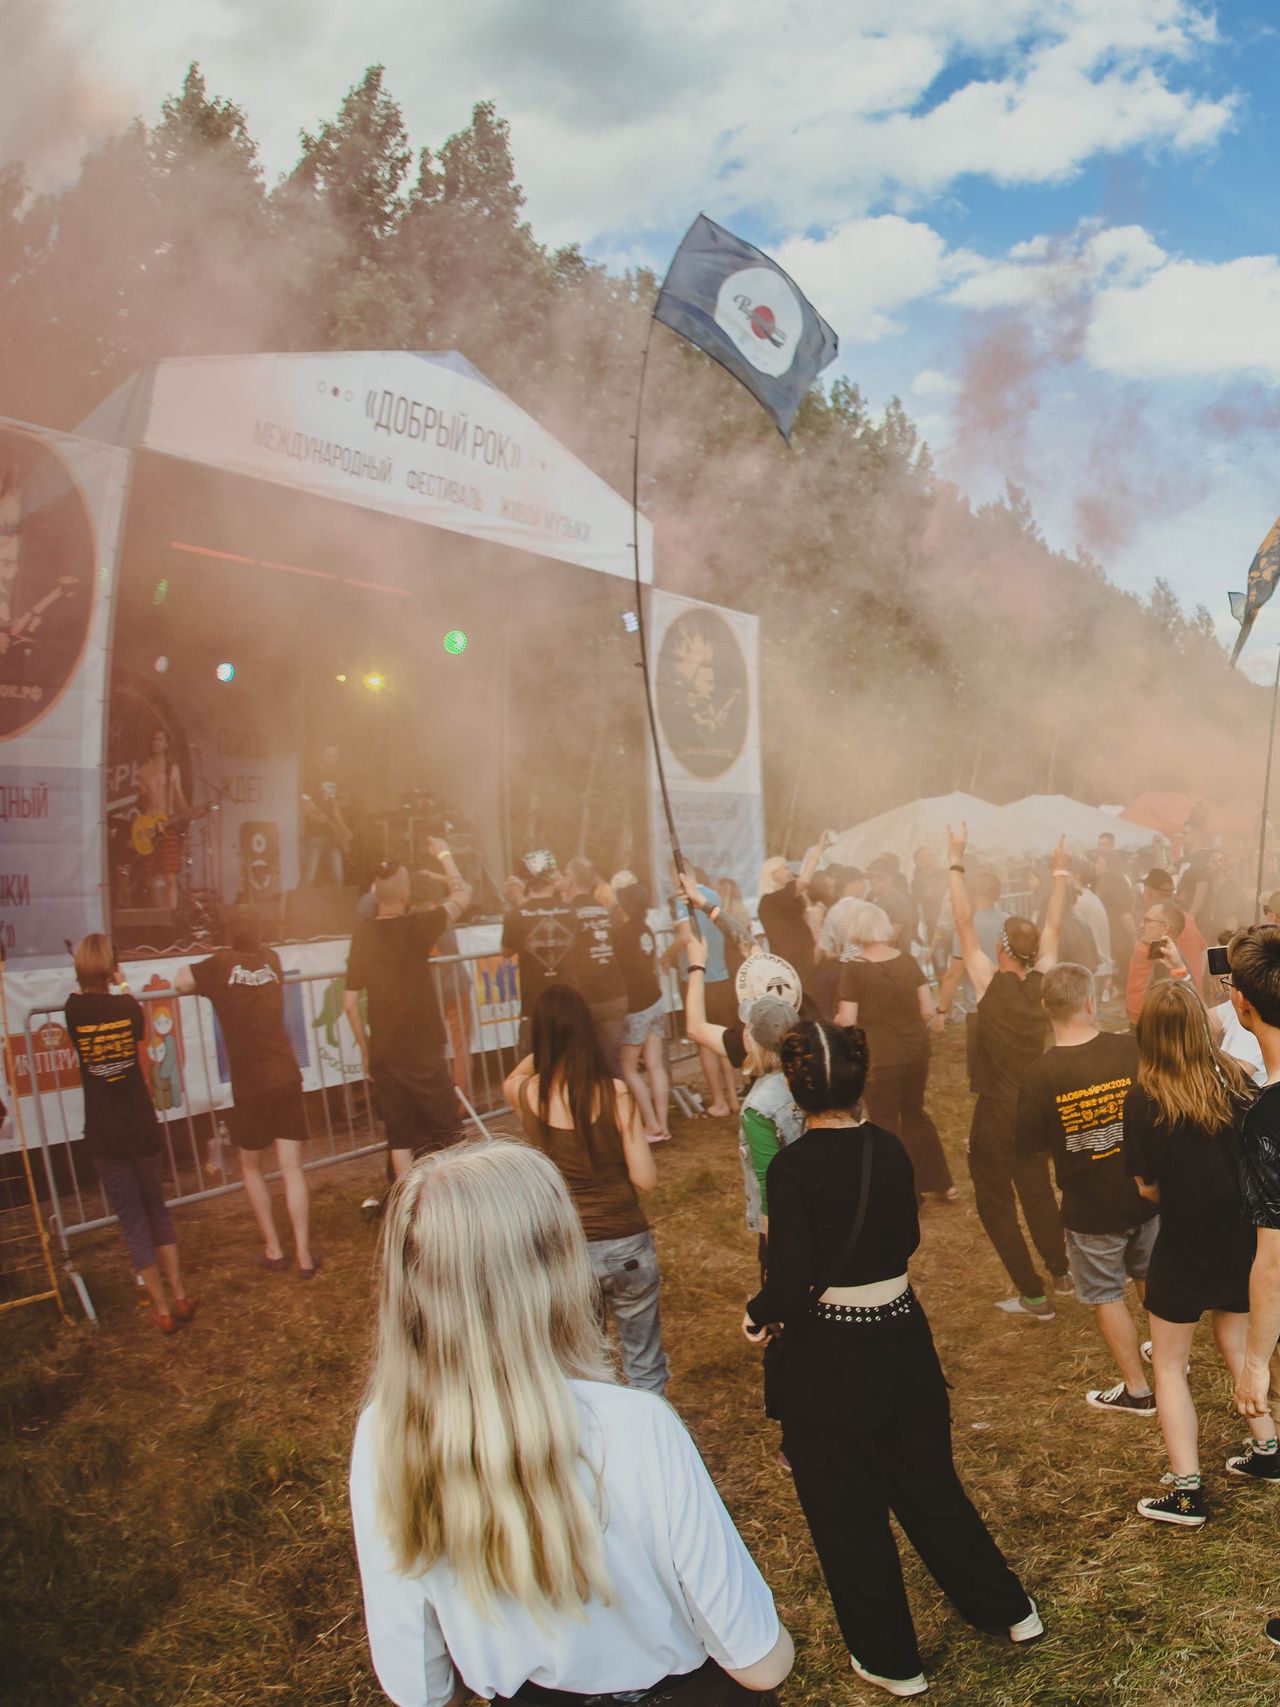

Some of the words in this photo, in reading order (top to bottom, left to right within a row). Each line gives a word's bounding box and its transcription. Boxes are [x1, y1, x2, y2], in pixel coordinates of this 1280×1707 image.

[253, 419, 393, 485] МЕЖДУНАРОДНЫЙ
[406, 470, 485, 513] ФЕСТИВАЛЬ
[365, 389, 470, 452] «ДОБРЫЙ
[471, 424, 522, 471] РОК»
[1055, 1077, 1132, 1104] #ДОБРЫЙРОК2024
